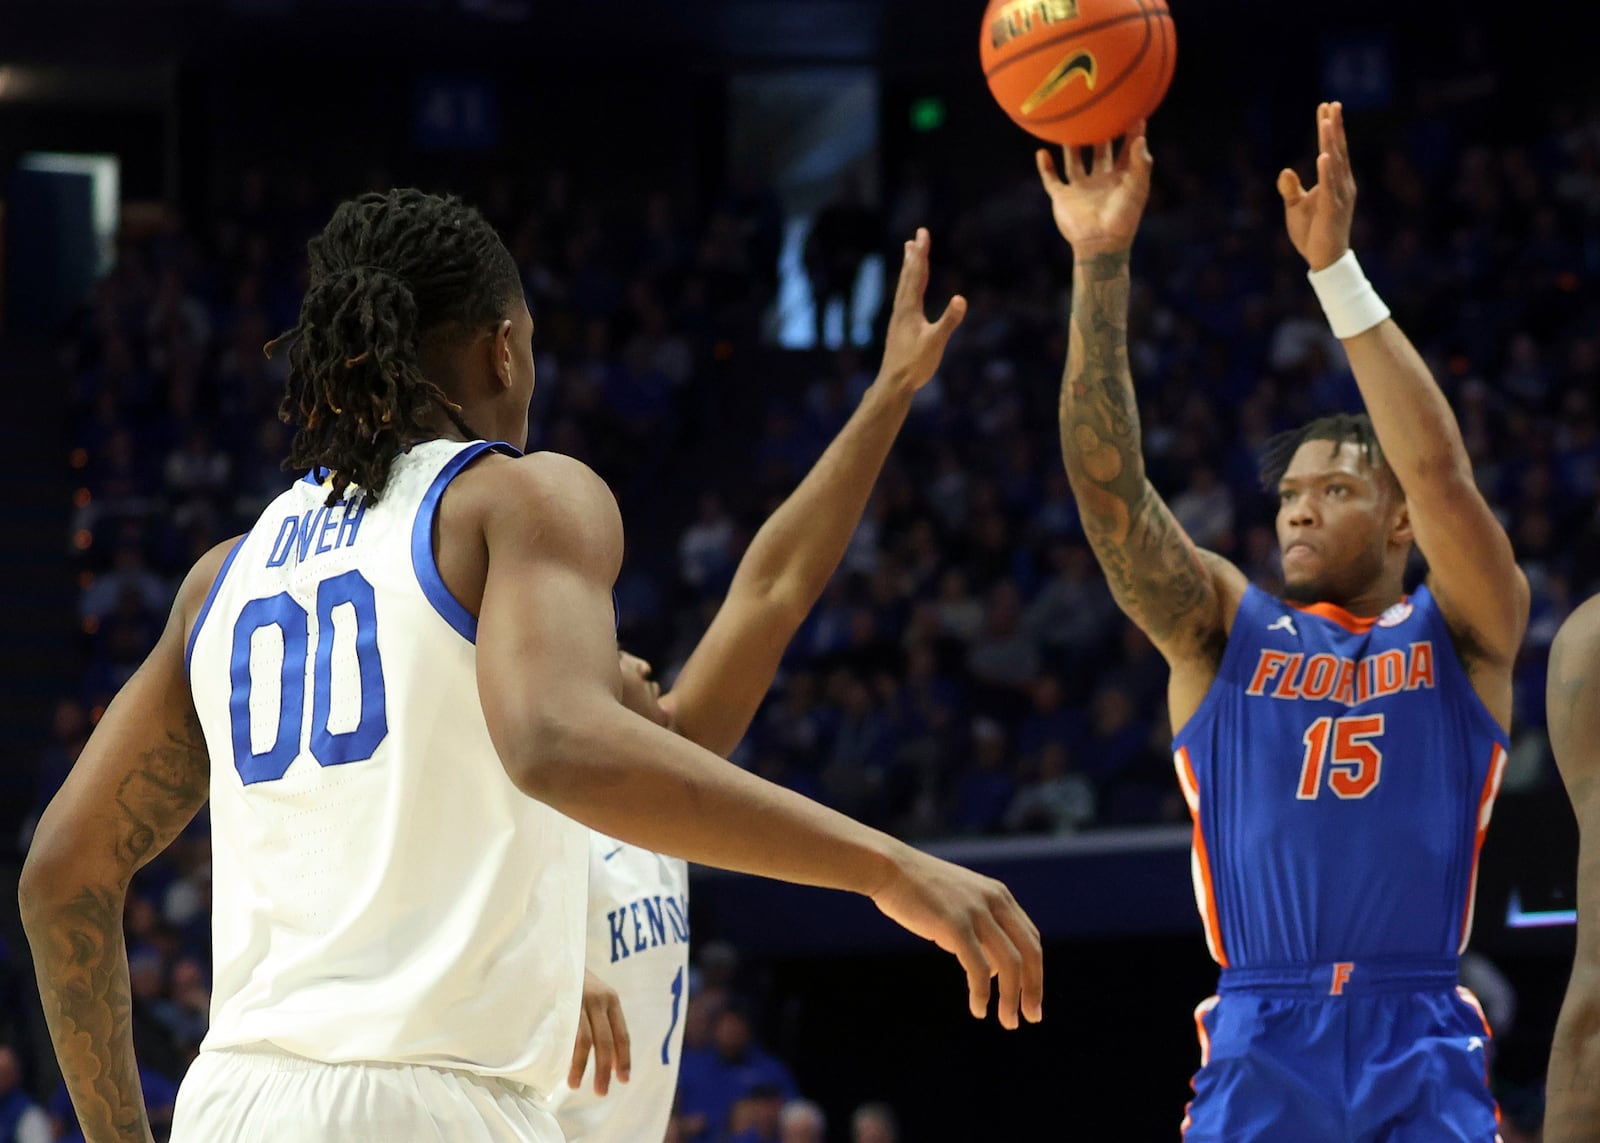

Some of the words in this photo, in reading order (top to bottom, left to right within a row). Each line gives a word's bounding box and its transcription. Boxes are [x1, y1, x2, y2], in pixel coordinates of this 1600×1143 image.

[230, 569, 389, 786] 00
[1245, 641, 1434, 707] FLORIDA
[1296, 713, 1384, 800] 15
[661, 965, 683, 1065] 1
[1329, 962, 1356, 996] F
